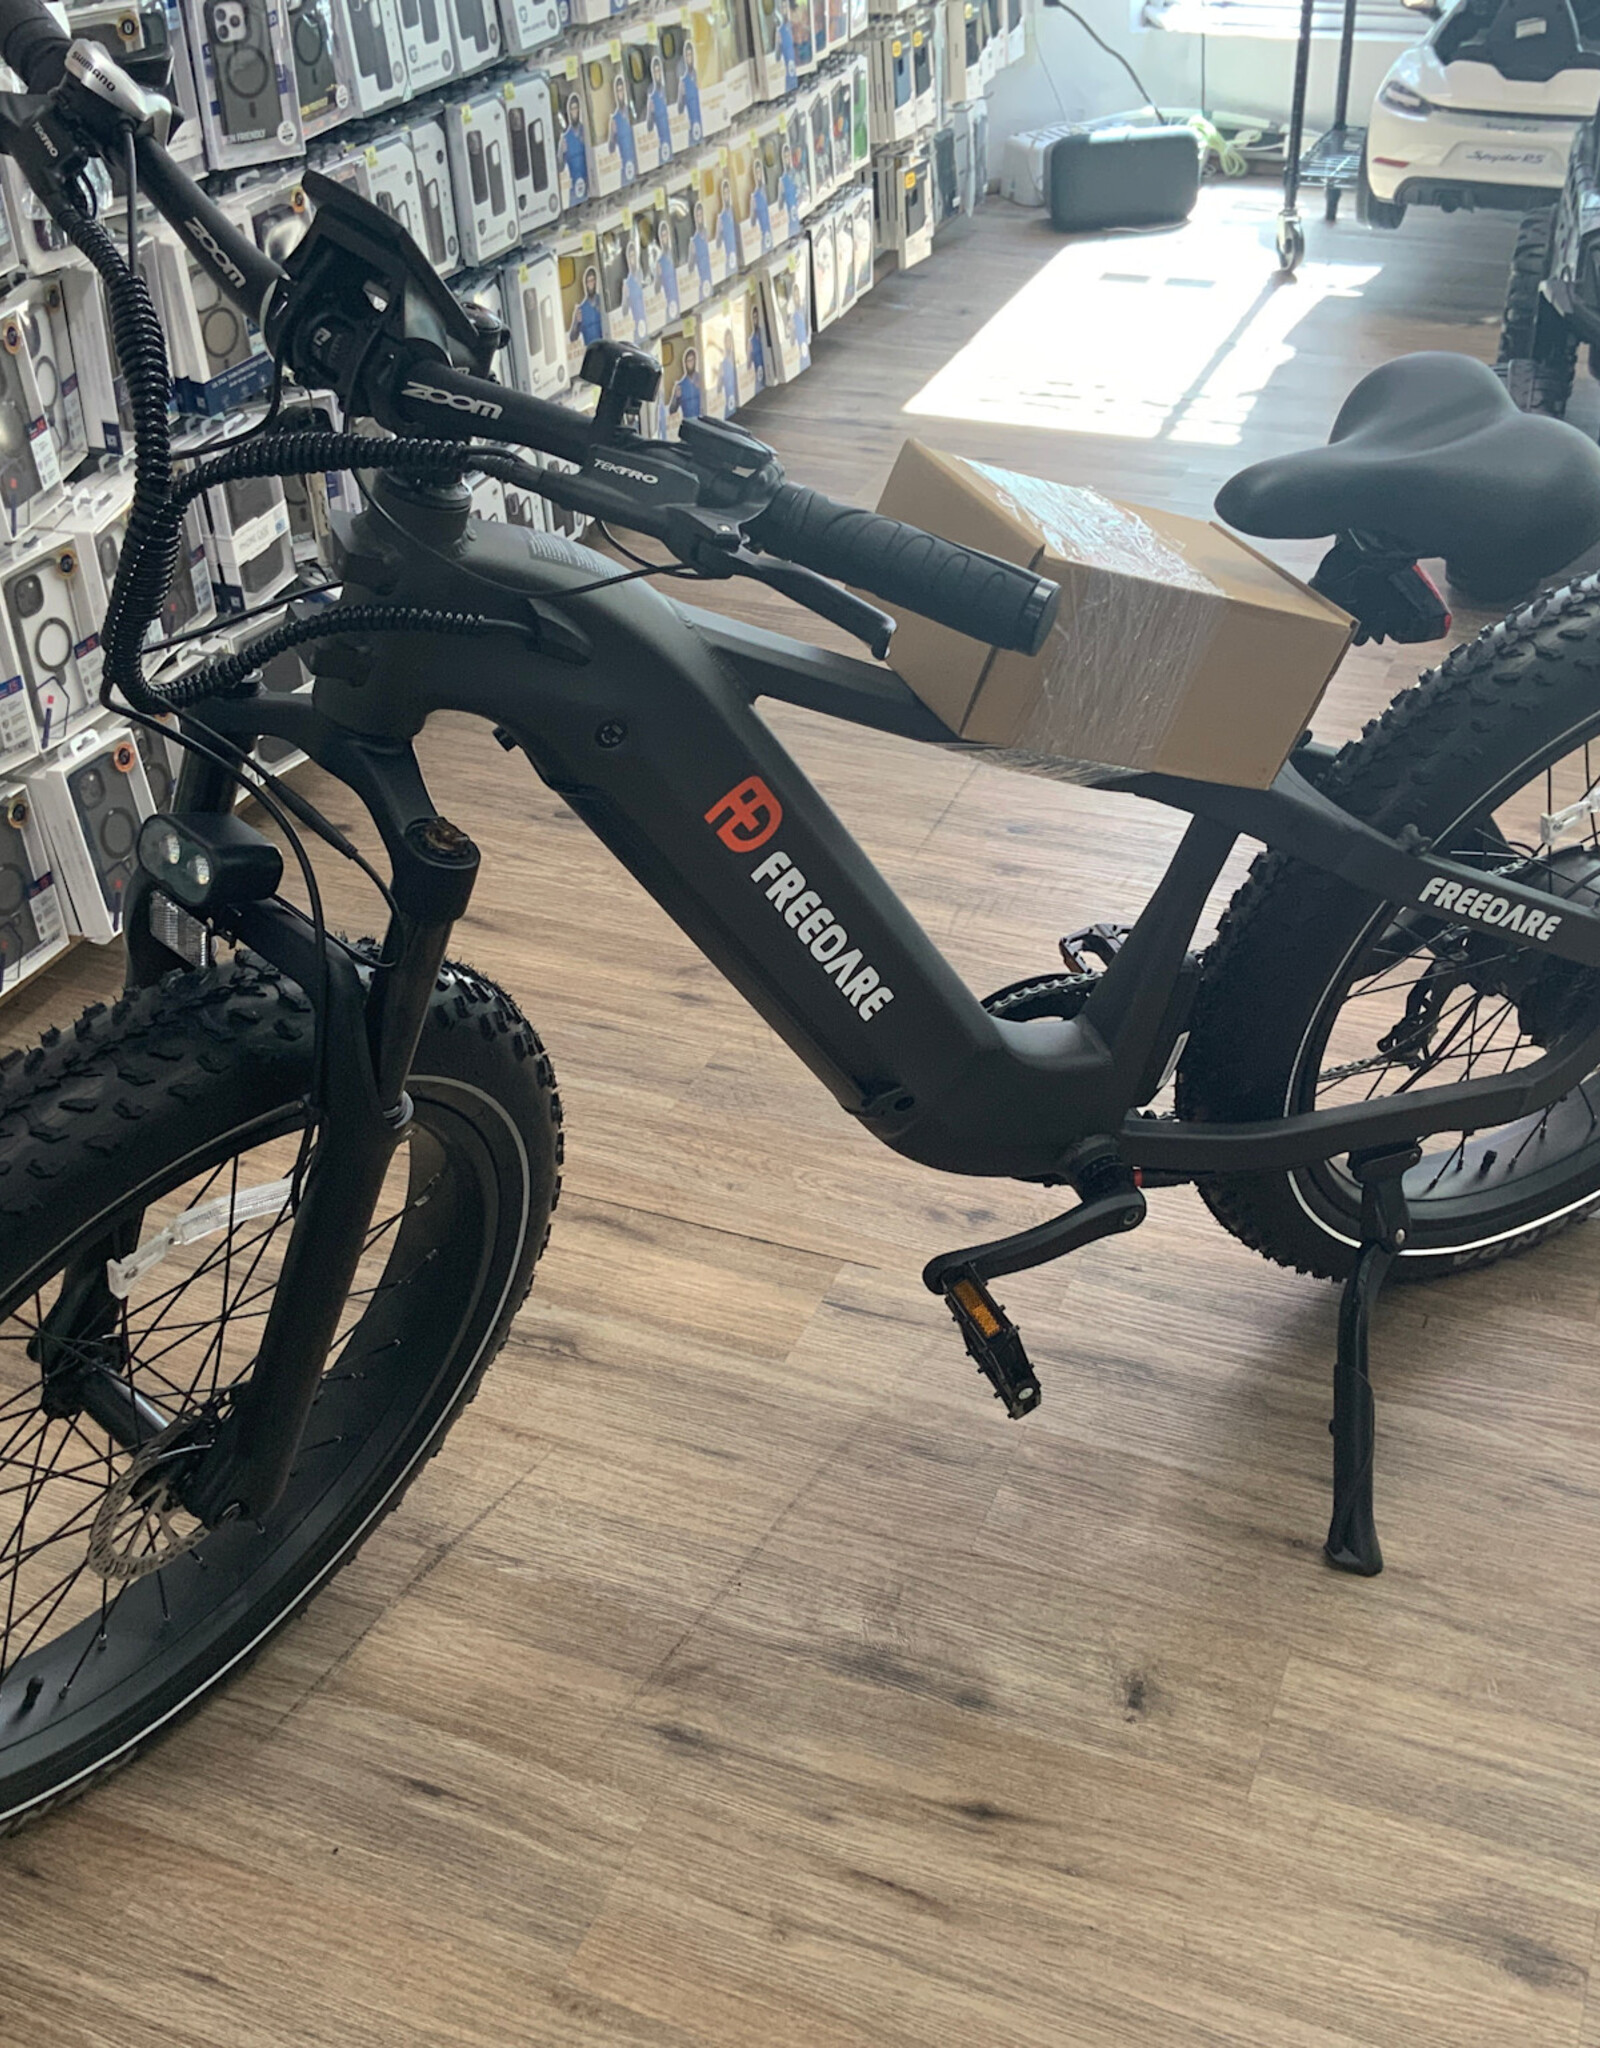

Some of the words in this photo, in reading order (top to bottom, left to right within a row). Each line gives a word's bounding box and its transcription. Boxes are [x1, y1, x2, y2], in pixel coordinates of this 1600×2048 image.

[71, 51, 116, 92] SHIMANO
[32, 121, 59, 157] TEKTRO
[1466, 150, 1521, 164] Spyder
[1521, 153, 1546, 164] RS
[593, 458, 659, 485] TEKTRO
